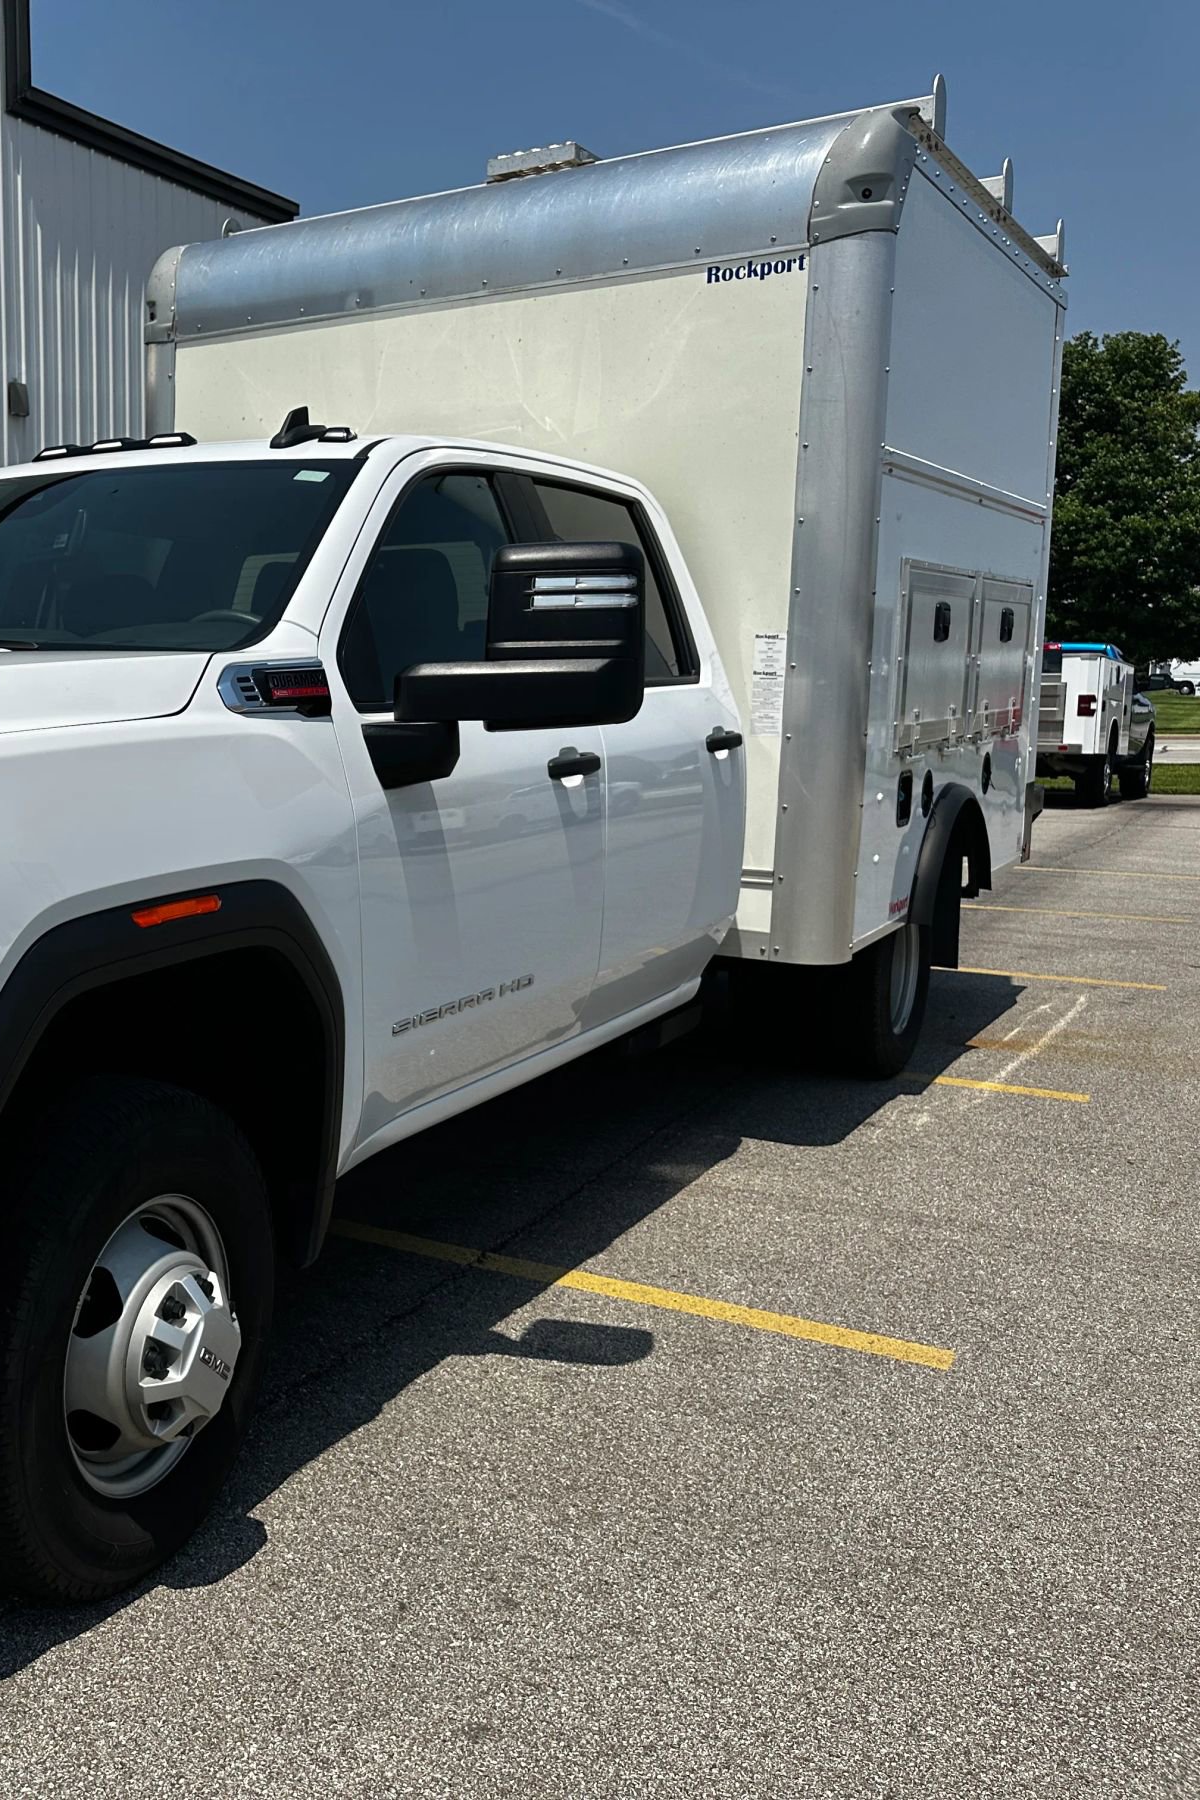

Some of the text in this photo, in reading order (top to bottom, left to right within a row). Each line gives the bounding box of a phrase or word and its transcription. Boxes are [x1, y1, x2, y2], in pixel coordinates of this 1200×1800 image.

[706, 253, 806, 284] Rockport
[271, 672, 327, 688] DURAMAX
[392, 973, 535, 1038] SIERRA HD
[198, 1345, 231, 1381] GMC
